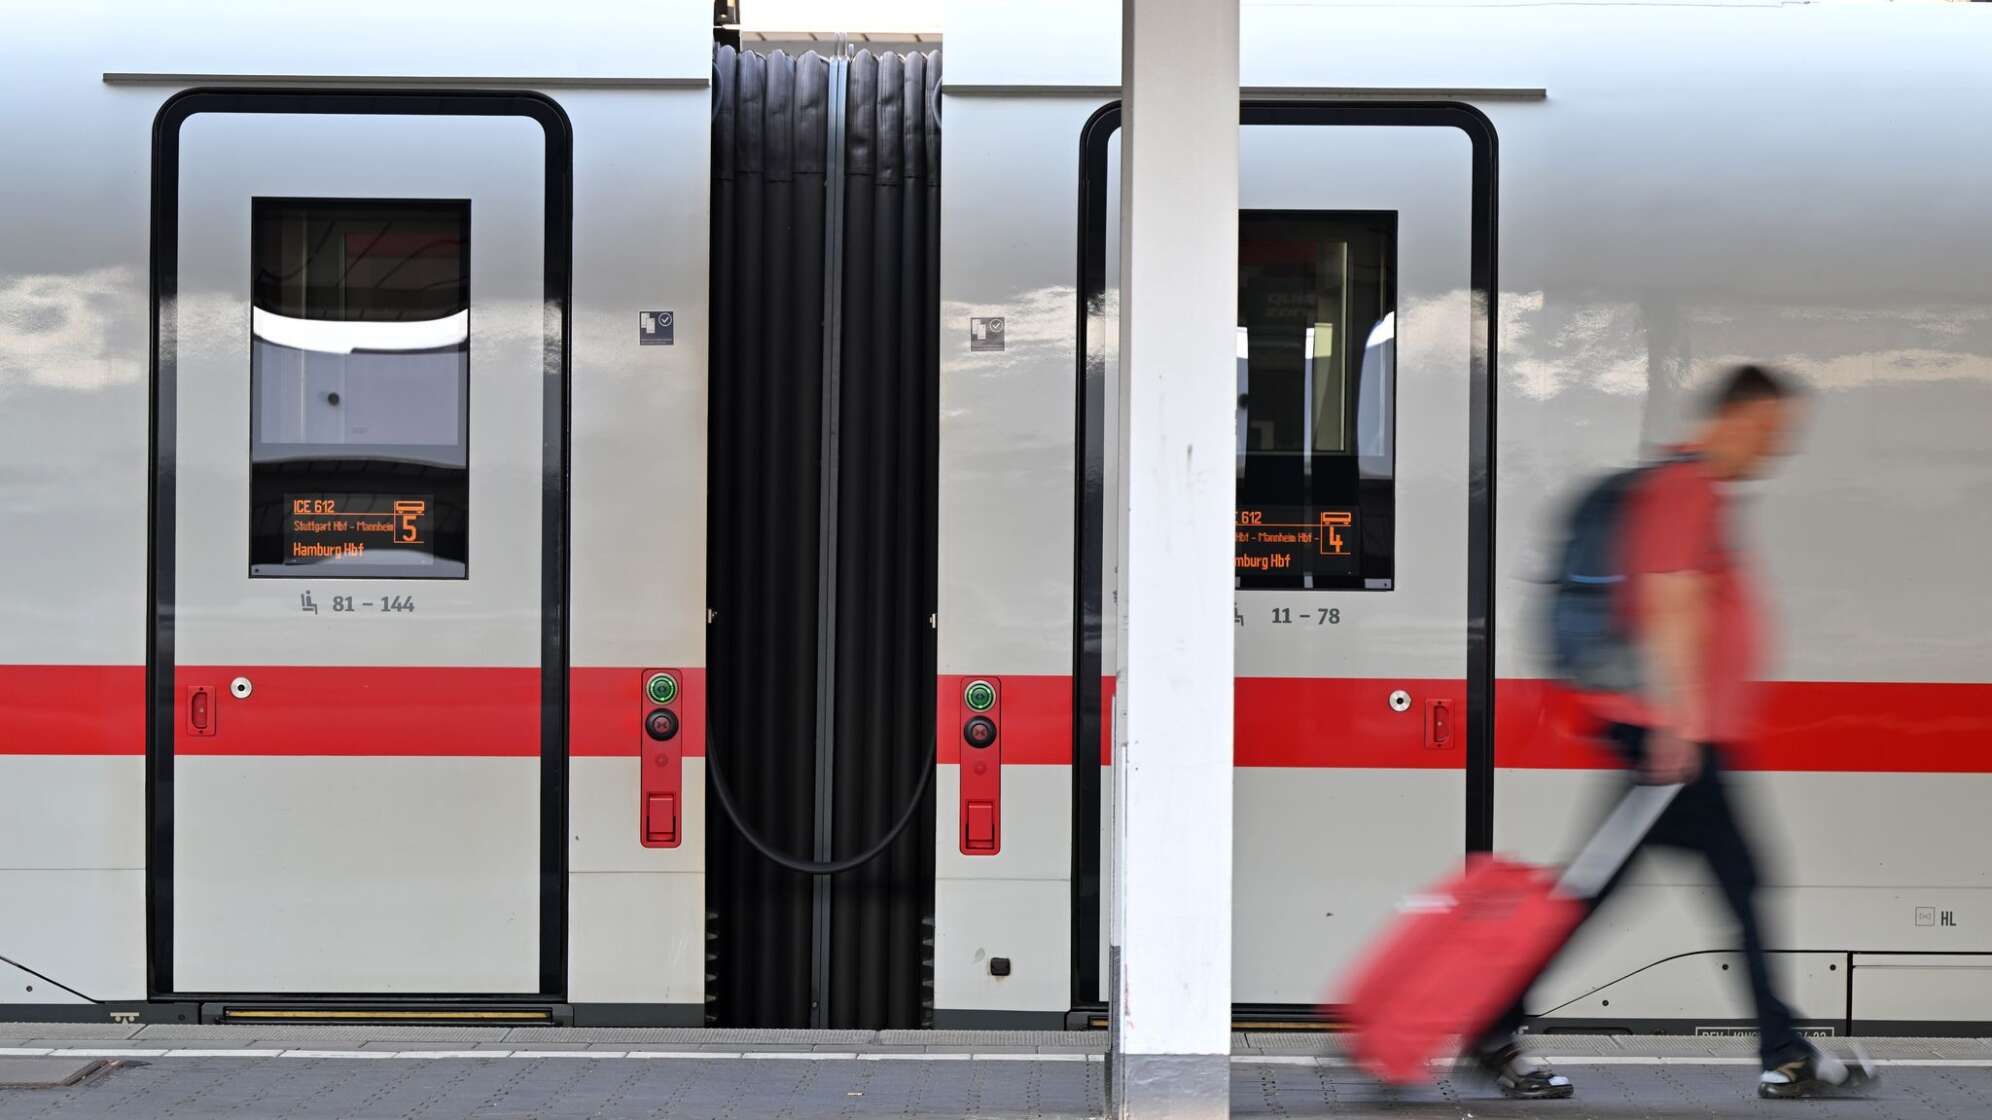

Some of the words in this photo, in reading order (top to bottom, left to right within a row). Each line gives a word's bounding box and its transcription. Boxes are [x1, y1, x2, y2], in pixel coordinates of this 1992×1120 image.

[294, 500, 311, 513] ICE
[315, 500, 335, 513] 612
[1241, 511, 1262, 525] 612
[294, 521, 331, 533] Stuttgart
[334, 521, 347, 532] Hbf
[357, 521, 394, 532] Mannheim
[402, 515, 416, 542] 5
[1258, 532, 1296, 542] Mannheim
[1298, 532, 1312, 542] Hbf
[1329, 526, 1343, 553] 4
[293, 542, 341, 560] Hamburg
[344, 542, 364, 557] Hbf
[1234, 553, 1269, 570] mburg
[1270, 553, 1291, 568] Hbf
[332, 596, 354, 612] 81
[381, 596, 415, 612] 144
[1272, 608, 1292, 623] 11
[1318, 608, 1340, 624] 78
[1941, 911, 1957, 926] HL
